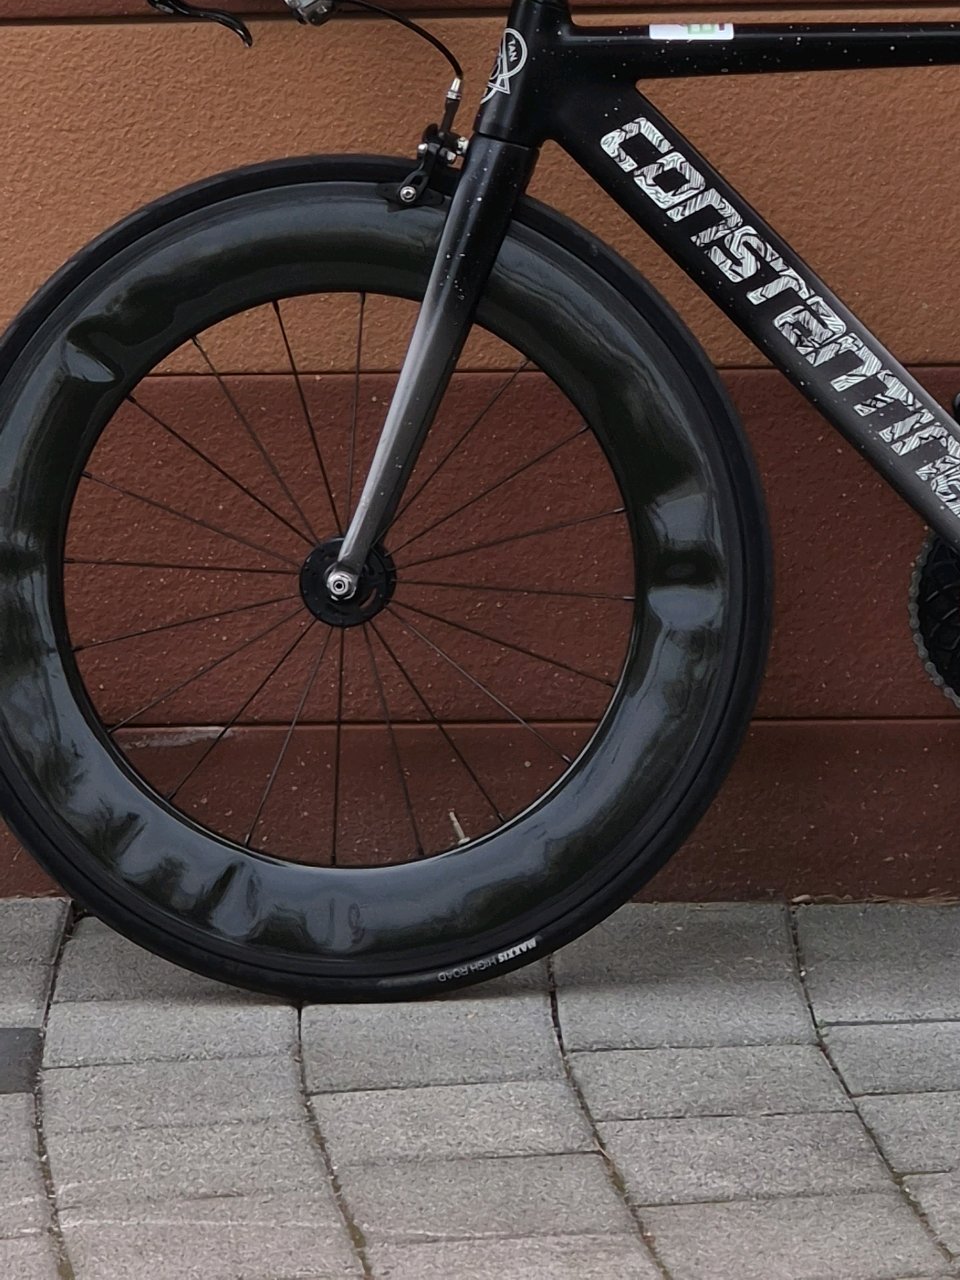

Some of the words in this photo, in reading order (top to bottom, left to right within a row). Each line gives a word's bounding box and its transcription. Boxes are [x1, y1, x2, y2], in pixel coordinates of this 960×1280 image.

[497, 937, 538, 964] MAXXIS
[470, 957, 498, 973] HIGH
[436, 967, 469, 982] ROAD
